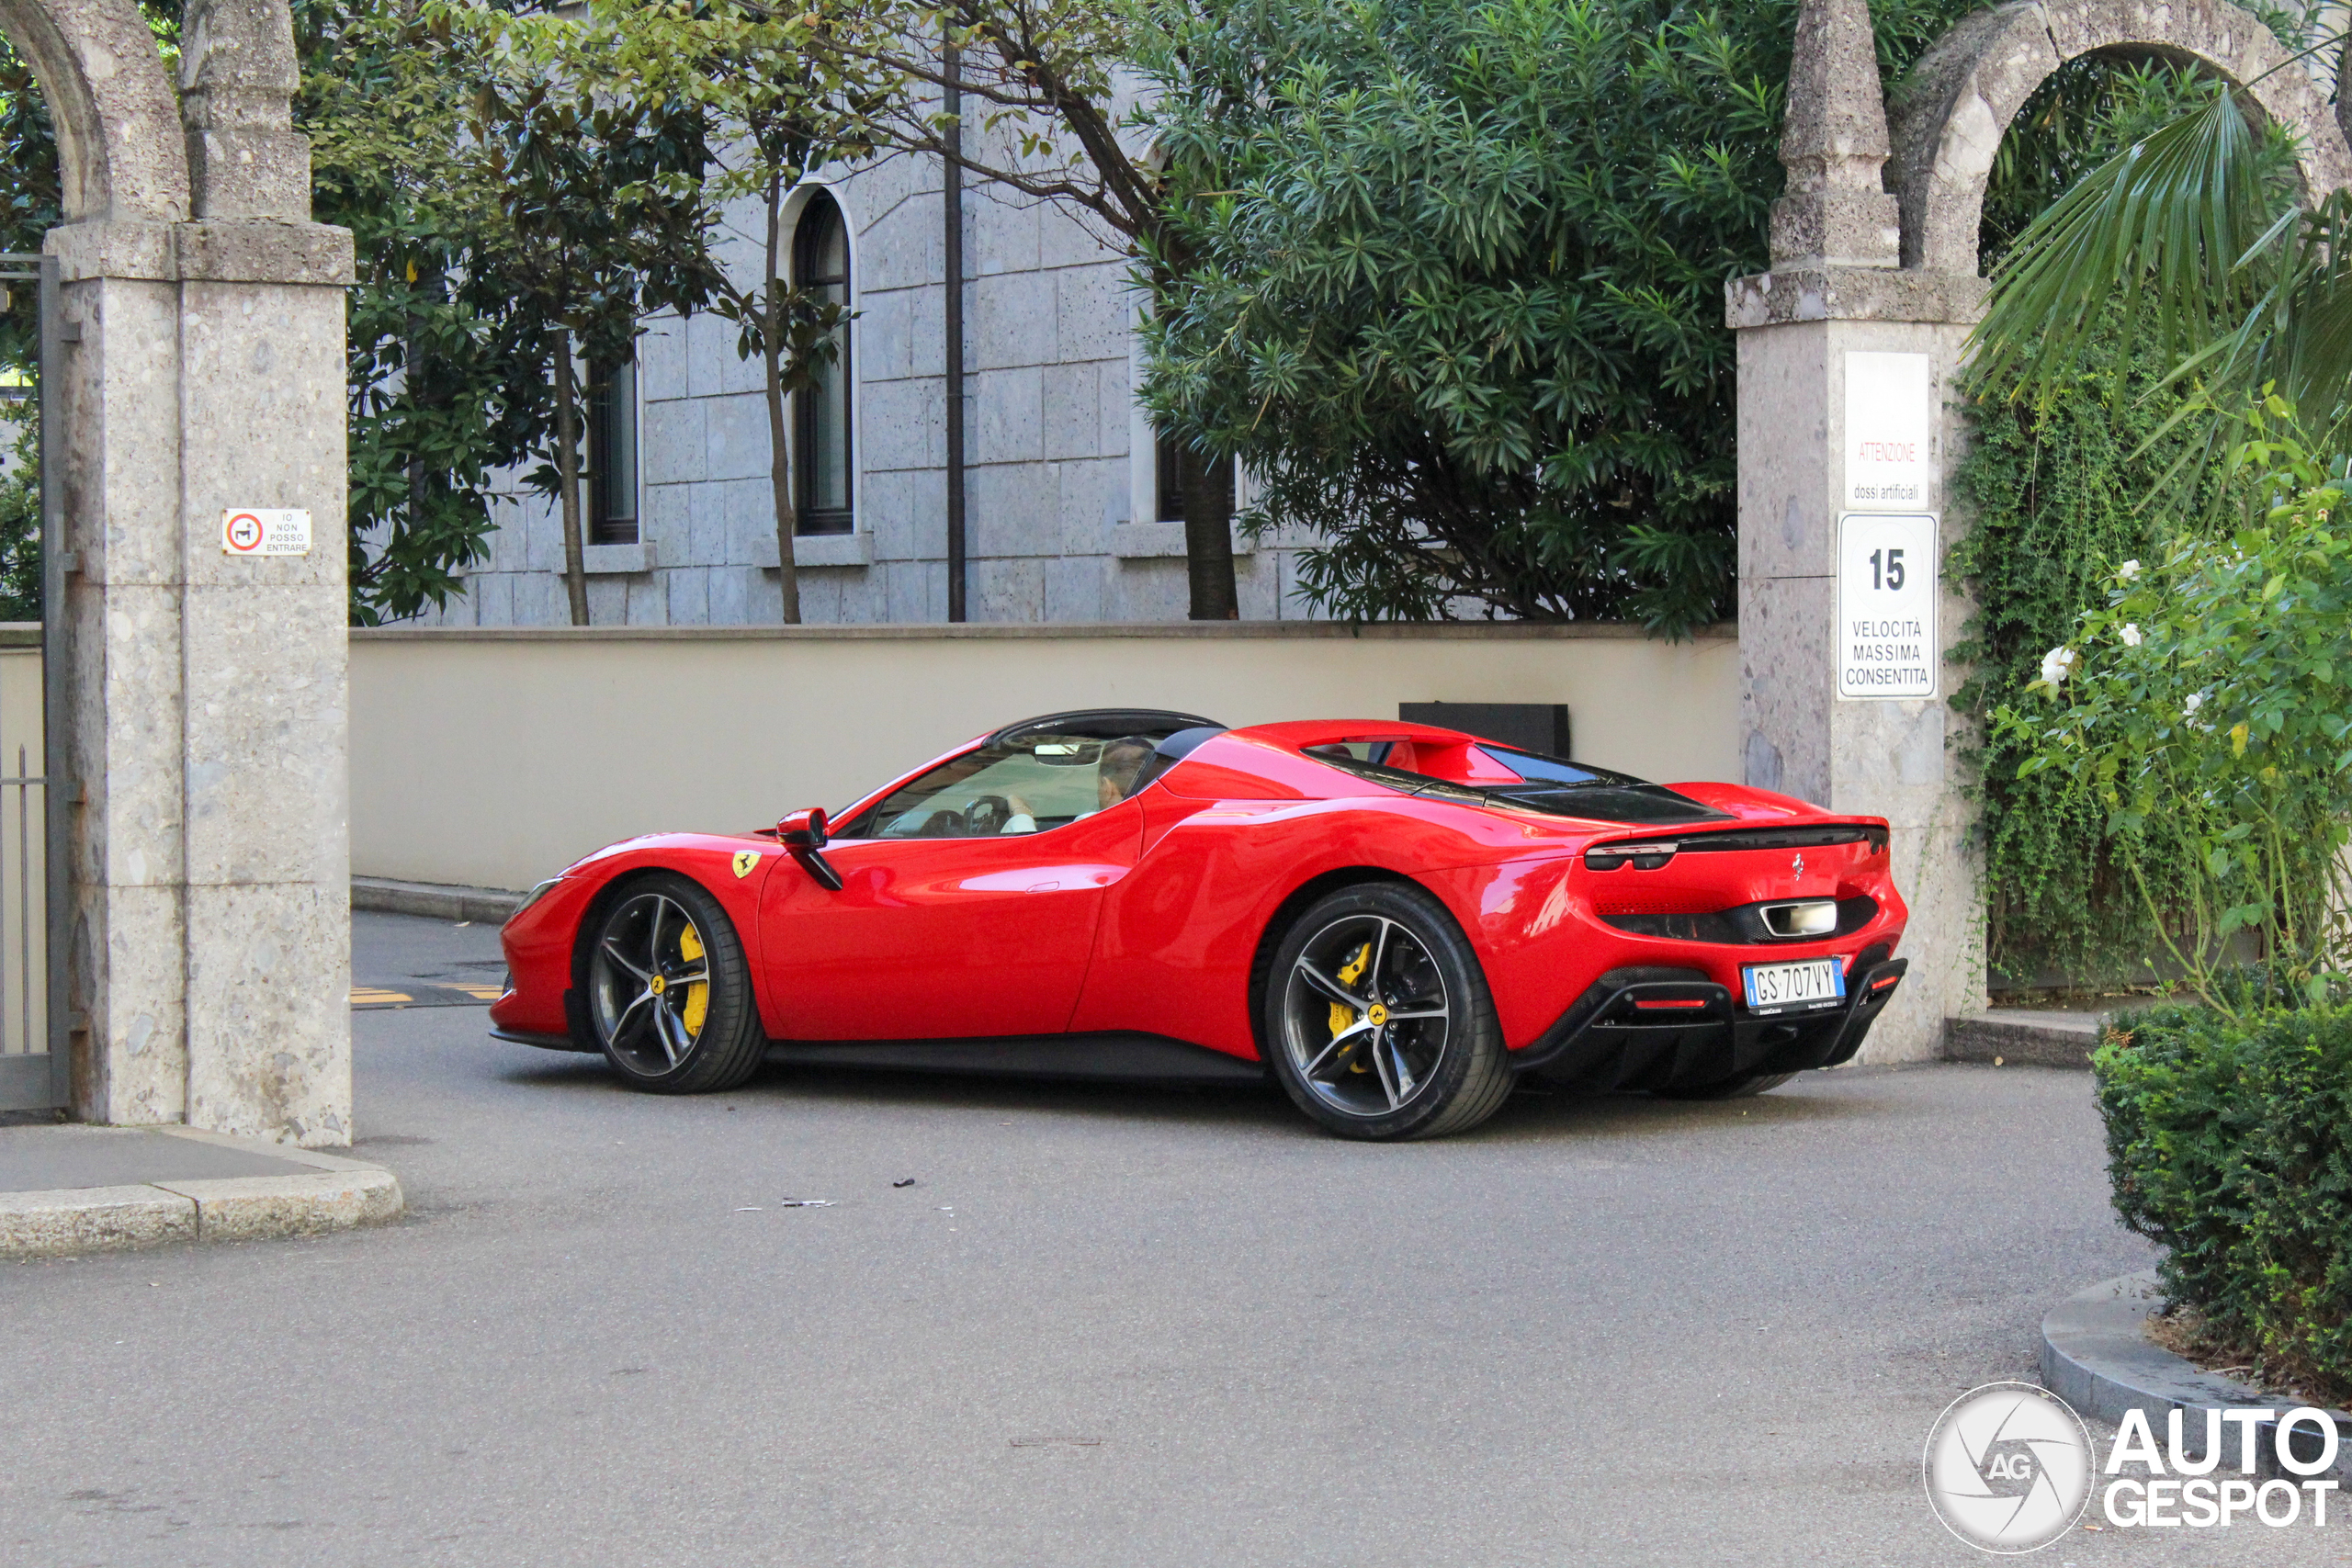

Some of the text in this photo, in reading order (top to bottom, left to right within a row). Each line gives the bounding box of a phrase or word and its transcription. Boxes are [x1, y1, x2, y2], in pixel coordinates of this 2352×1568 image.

[1859, 442, 1916, 463] ATTENZIONE
[1854, 483, 1919, 501] dossi artificiali
[282, 513, 292, 522] IO
[277, 524, 298, 532] NON
[270, 534, 304, 542] POSSO
[266, 544, 308, 552] ENTRARE
[1869, 548, 1905, 591] 15
[1852, 617, 1922, 637] VELOCITÀ
[1853, 644, 1920, 661] MASSIMA
[1846, 668, 1928, 685] CONSENTITA
